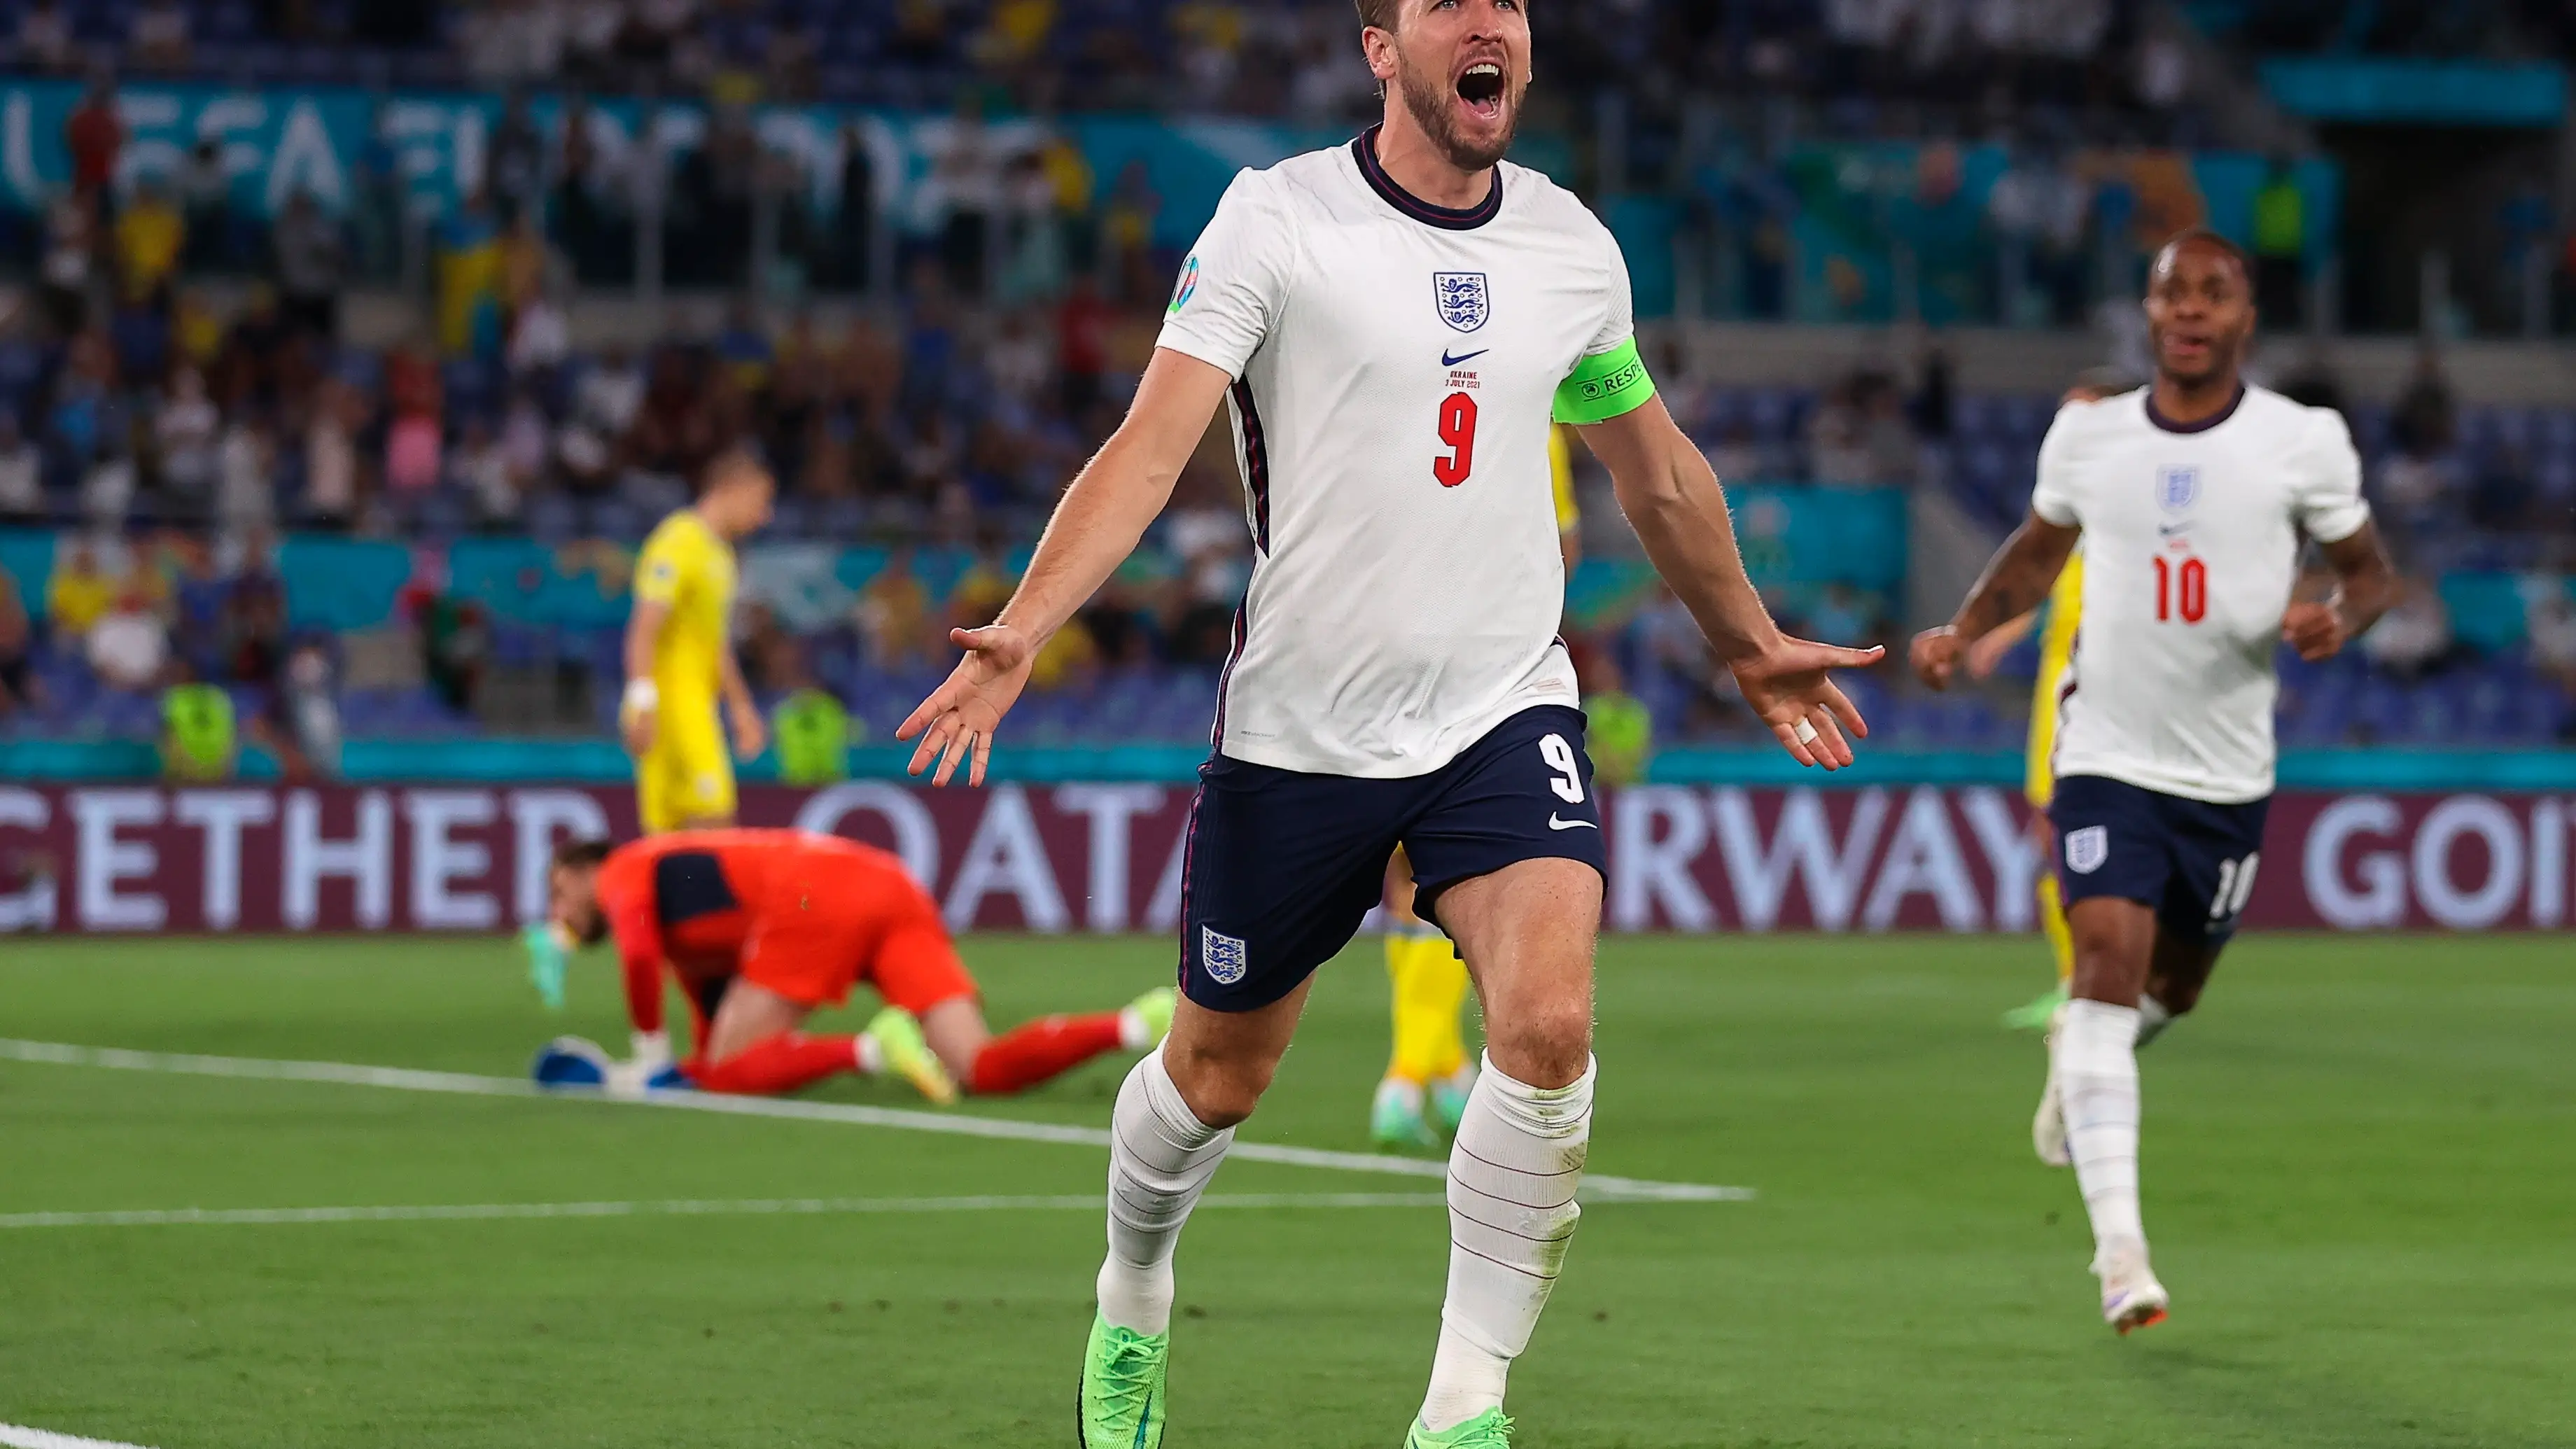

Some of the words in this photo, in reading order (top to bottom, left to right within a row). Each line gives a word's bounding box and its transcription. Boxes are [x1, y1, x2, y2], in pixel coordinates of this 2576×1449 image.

[1450, 370, 1477, 379] UKRAINE
[1466, 381, 1480, 389] 2021
[1433, 391, 1478, 488] 9
[2152, 554, 2208, 624] 10
[1538, 733, 1586, 804] 9
[2208, 851, 2260, 919] 10
